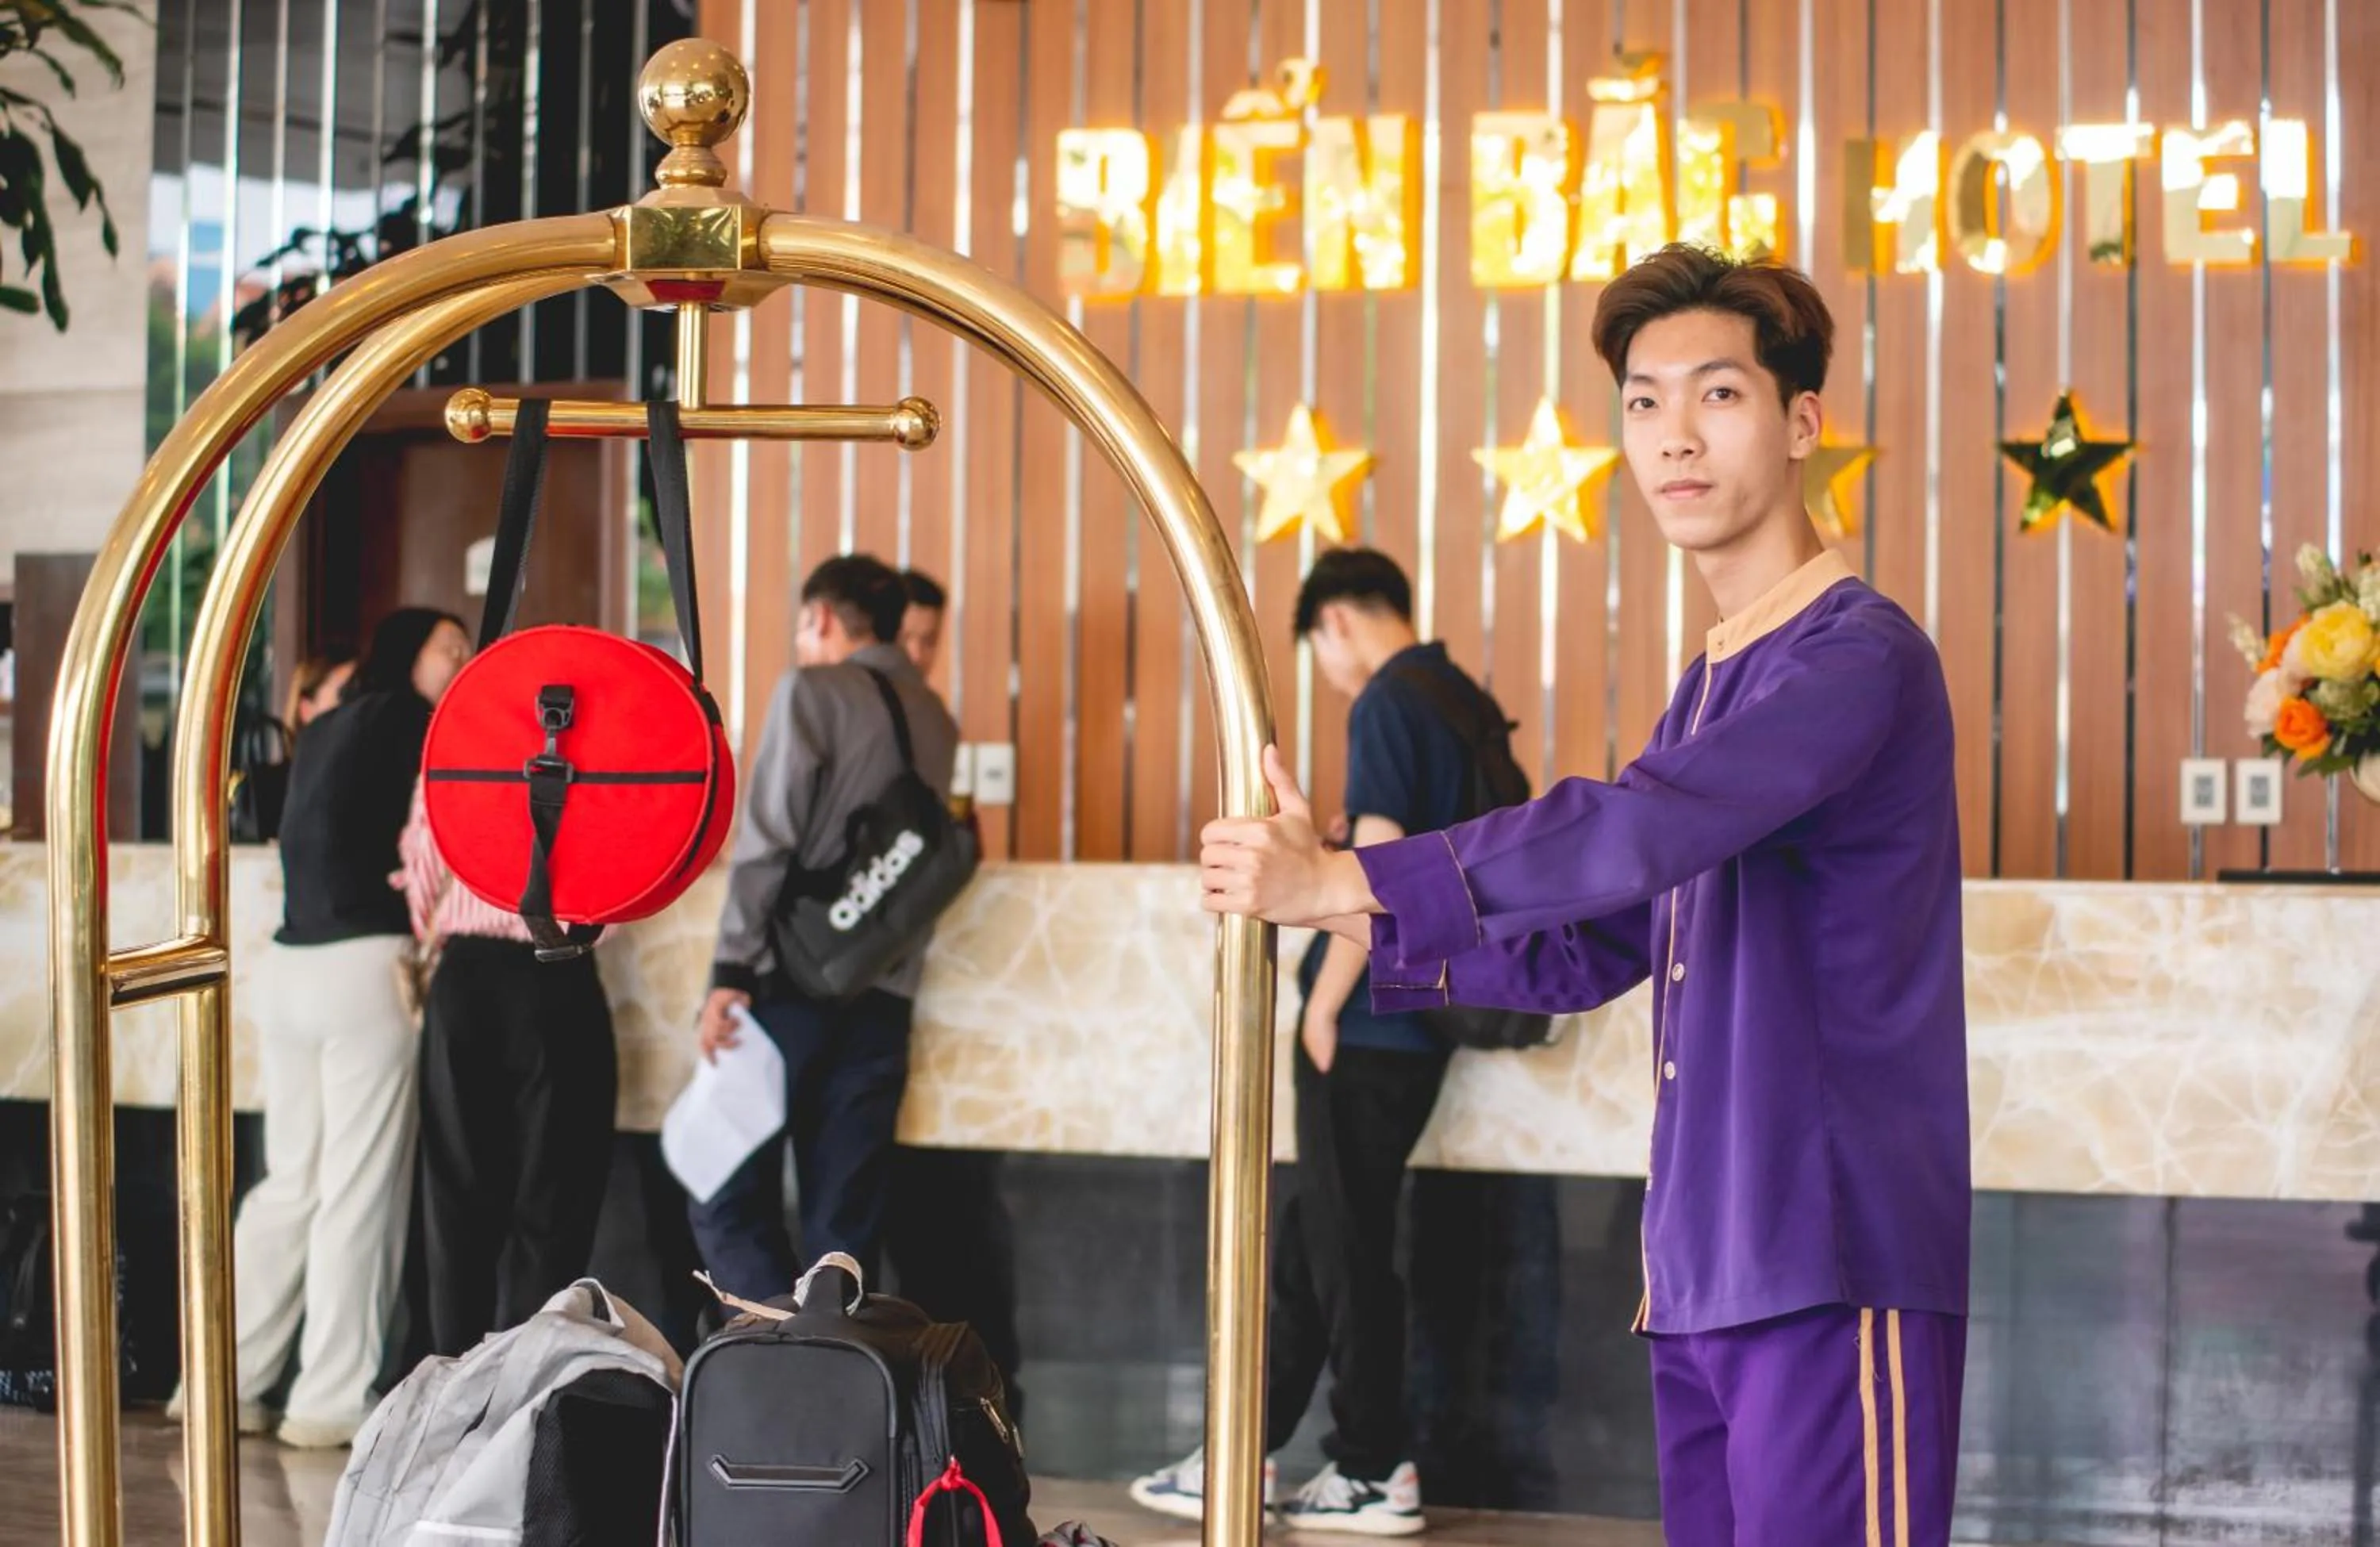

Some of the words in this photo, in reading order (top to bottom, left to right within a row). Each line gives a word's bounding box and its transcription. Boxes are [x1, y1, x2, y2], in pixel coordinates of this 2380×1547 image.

[1057, 56, 1420, 298] BIỂN
[1842, 119, 2359, 274] HOTEL
[829, 829, 924, 931] adidas
